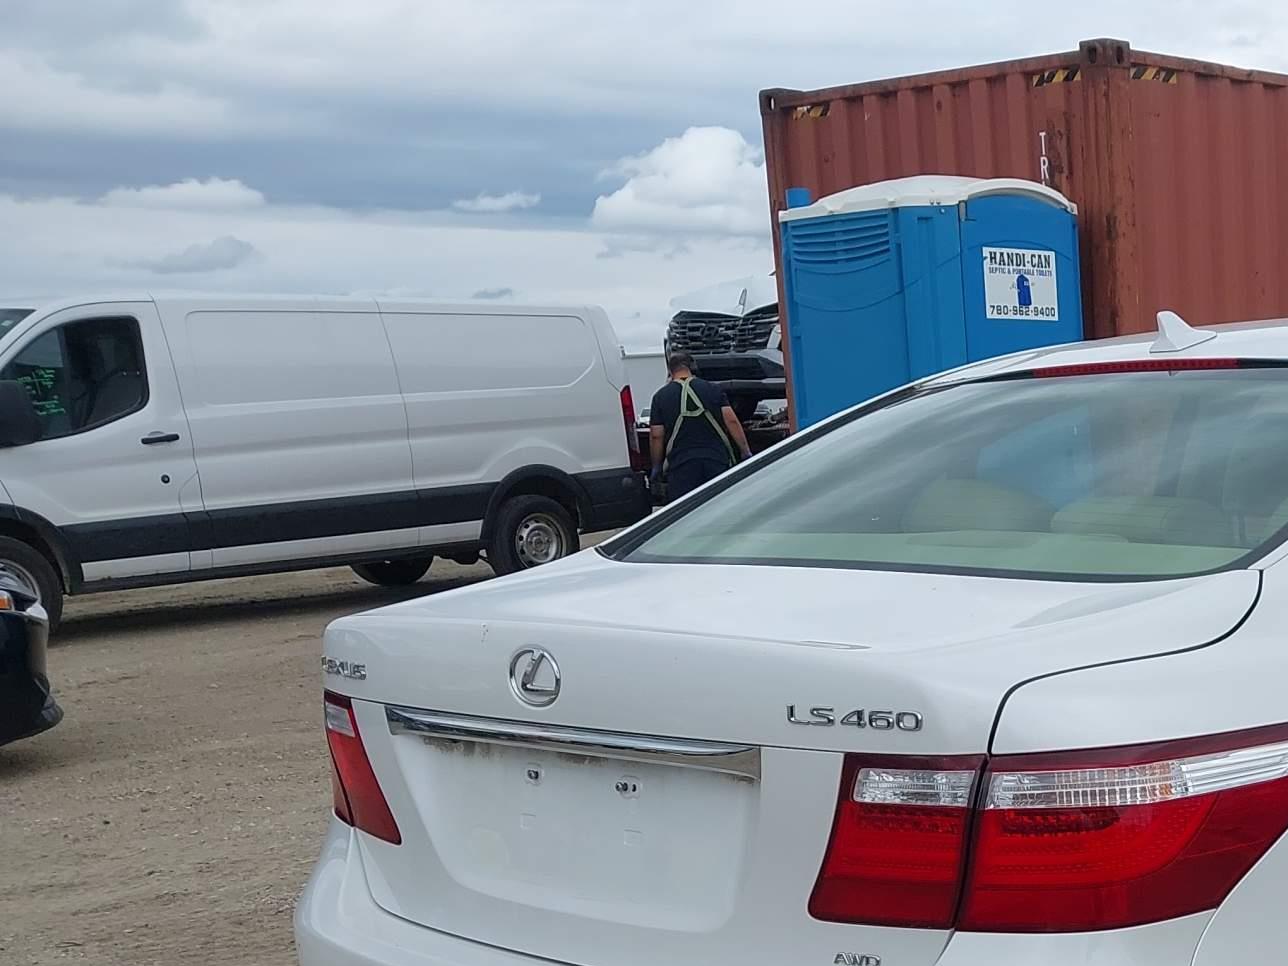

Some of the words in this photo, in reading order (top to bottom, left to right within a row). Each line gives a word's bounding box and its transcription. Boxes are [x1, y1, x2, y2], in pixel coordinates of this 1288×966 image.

[1039, 132, 1049, 185] TR
[787, 704, 834, 726] LS
[840, 709, 924, 732] 460
